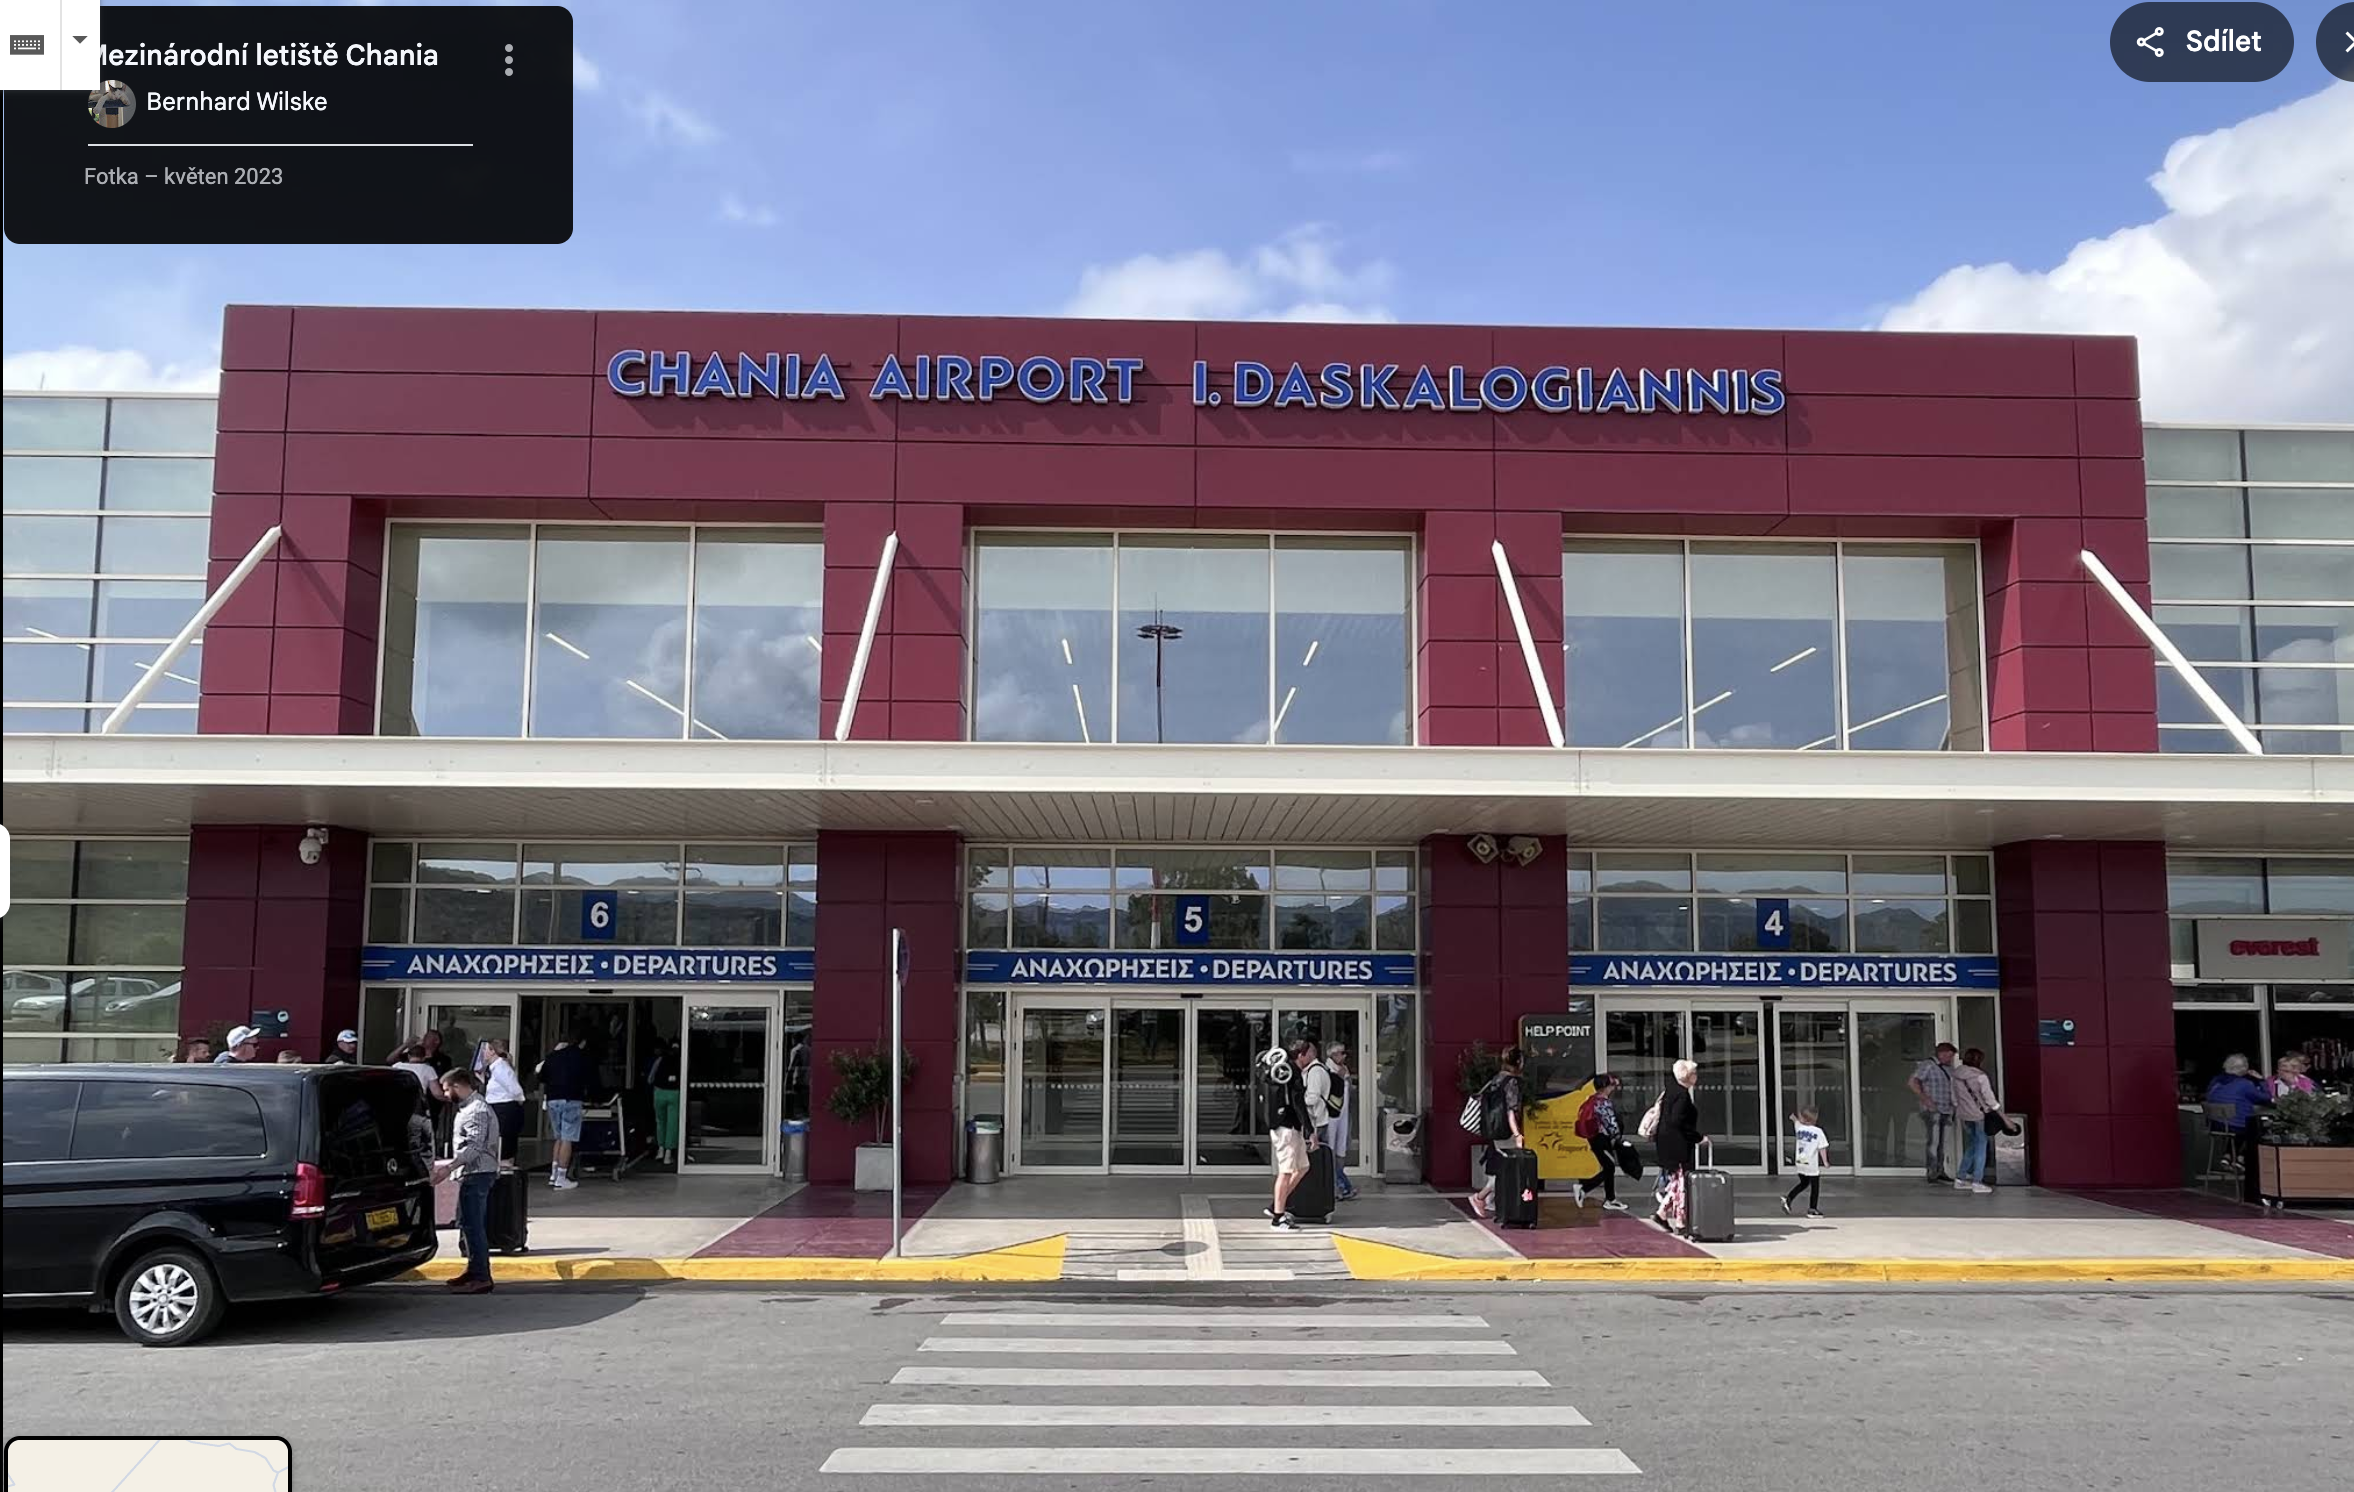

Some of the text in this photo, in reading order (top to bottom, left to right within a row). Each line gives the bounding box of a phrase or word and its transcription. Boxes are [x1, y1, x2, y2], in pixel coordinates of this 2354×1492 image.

[607, 349, 846, 400] CHANIA
[868, 354, 1144, 406] AIRPORT
[591, 901, 609, 928] 6
[1184, 906, 1203, 933] 5
[1764, 910, 1784, 936] 4
[406, 953, 777, 976] ΑΝΑΧΩΡΗΣΕΙΣ DEPARTURES
[1011, 957, 1373, 980] ΑΝΑΧΩΡΗΣΕΙΣ DEPARTURES
[1602, 960, 1958, 982] ΑΝΑΧΩΡΗΣΕΙΣ DEPARTURES
[1524, 1025, 1591, 1037] HELP POINT
